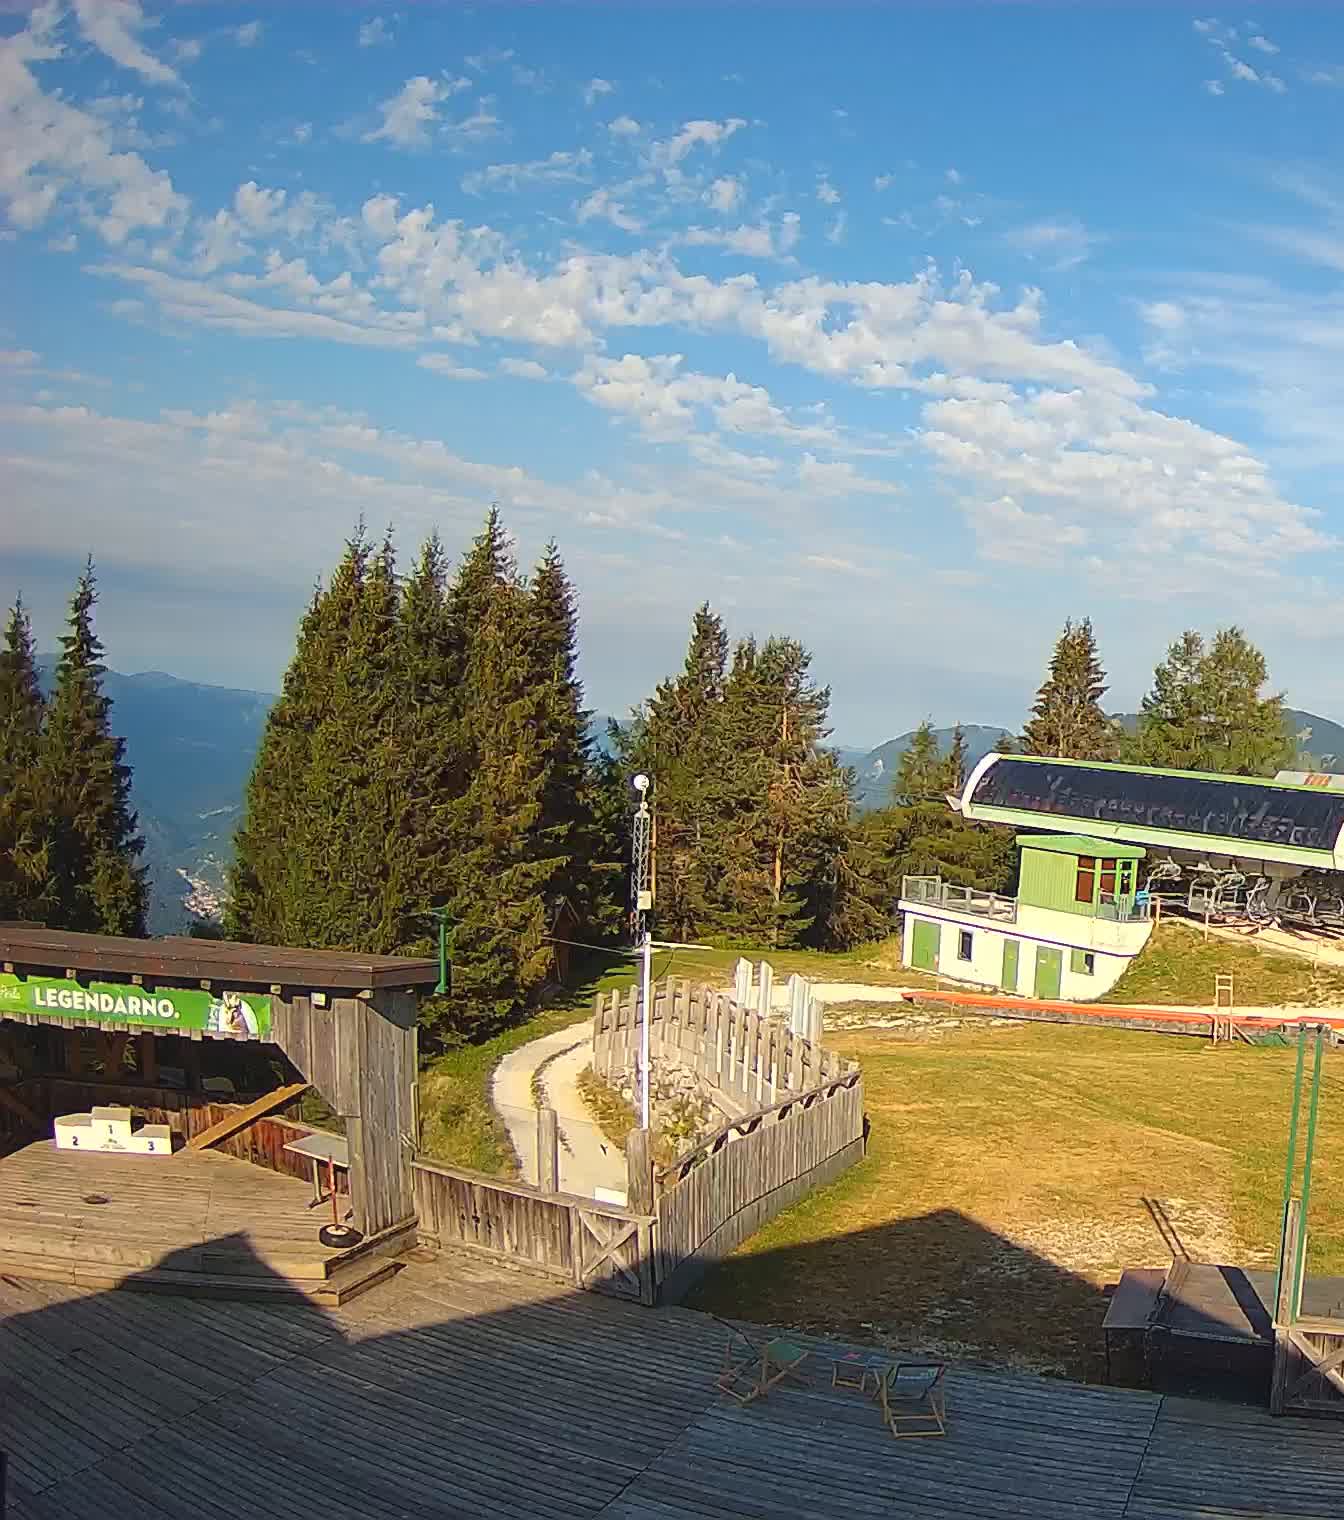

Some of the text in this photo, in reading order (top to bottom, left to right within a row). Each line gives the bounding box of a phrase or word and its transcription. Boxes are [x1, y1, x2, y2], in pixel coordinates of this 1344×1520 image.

[34, 986, 181, 1019] LEGENDARNO.
[72, 1135, 80, 1147] 2
[147, 1140, 156, 1151] 3
